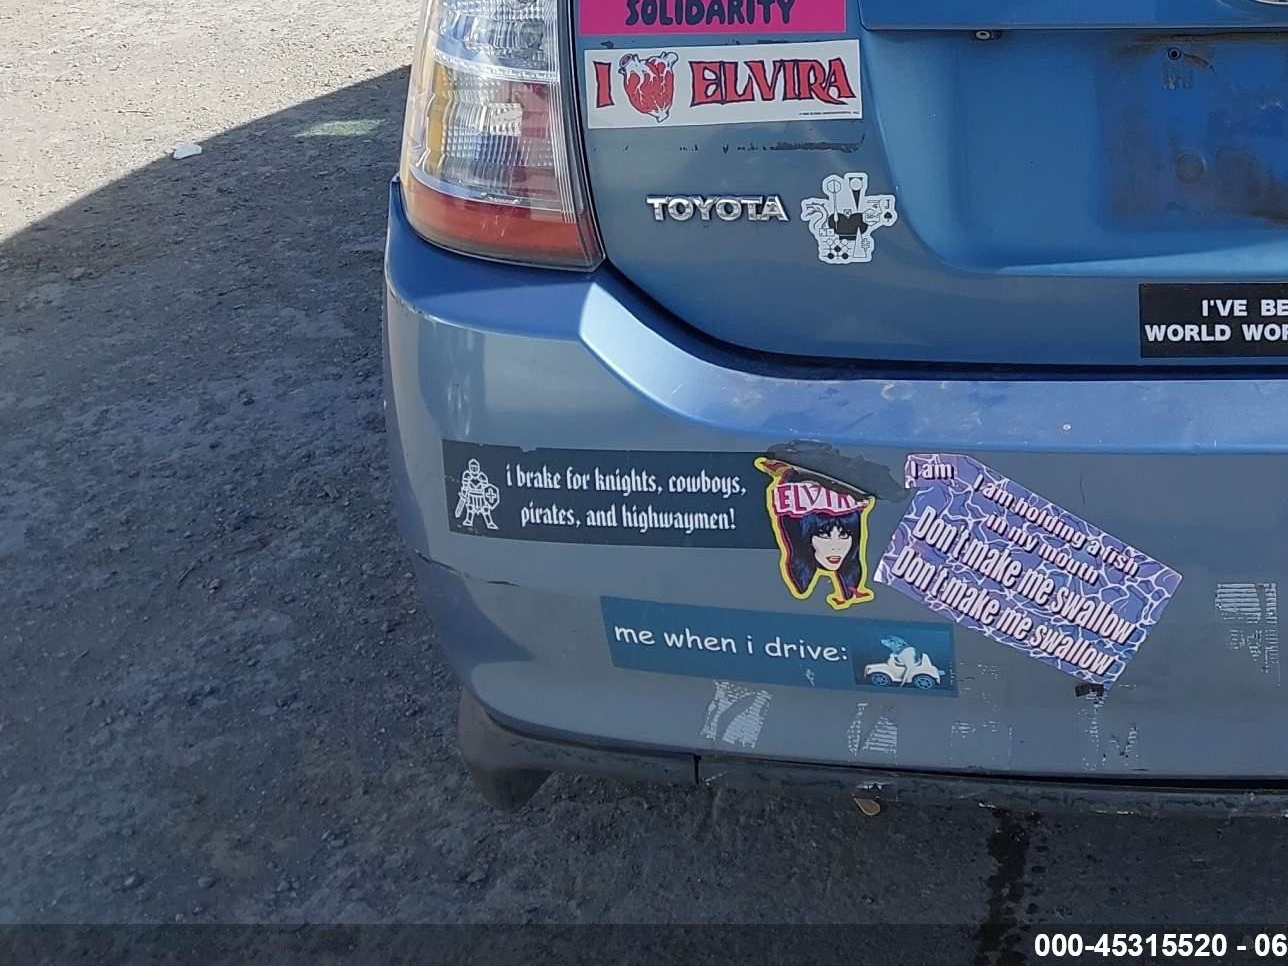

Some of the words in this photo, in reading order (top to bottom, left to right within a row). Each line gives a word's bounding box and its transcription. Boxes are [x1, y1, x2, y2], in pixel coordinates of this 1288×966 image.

[592, 60, 615, 109] I
[688, 56, 857, 108] ELVIRA
[647, 194, 790, 222] TOYOTA
[1202, 299, 1247, 317] I'VE
[1145, 324, 1231, 342] WORLD
[505, 464, 512, 487] i
[516, 464, 561, 490] brake
[567, 466, 590, 490] for
[595, 467, 663, 497] knights,
[668, 469, 748, 499] cowboys,
[911, 460, 919, 478] I
[922, 462, 954, 480] am
[520, 501, 581, 528] pirates,
[586, 504, 618, 527] and
[622, 503, 737, 534] highwaymen!
[973, 473, 984, 491] I
[982, 481, 1014, 509] am
[1014, 497, 1087, 550] holding
[1086, 537, 1102, 557] a
[1101, 545, 1140, 577] fish
[985, 510, 1008, 536] in
[1007, 525, 1039, 553] my
[1038, 542, 1100, 586] mouth
[911, 505, 971, 561] Don't
[961, 538, 1023, 589] make
[1016, 568, 1055, 605] me
[1050, 586, 1137, 645] swallow
[890, 544, 949, 599] Don't
[940, 575, 1001, 626] make
[995, 606, 1033, 641] me
[1029, 623, 1117, 676] swallow
[614, 626, 655, 645] me
[664, 627, 736, 654] when
[746, 635, 753, 654] i
[764, 636, 848, 662] drive:
